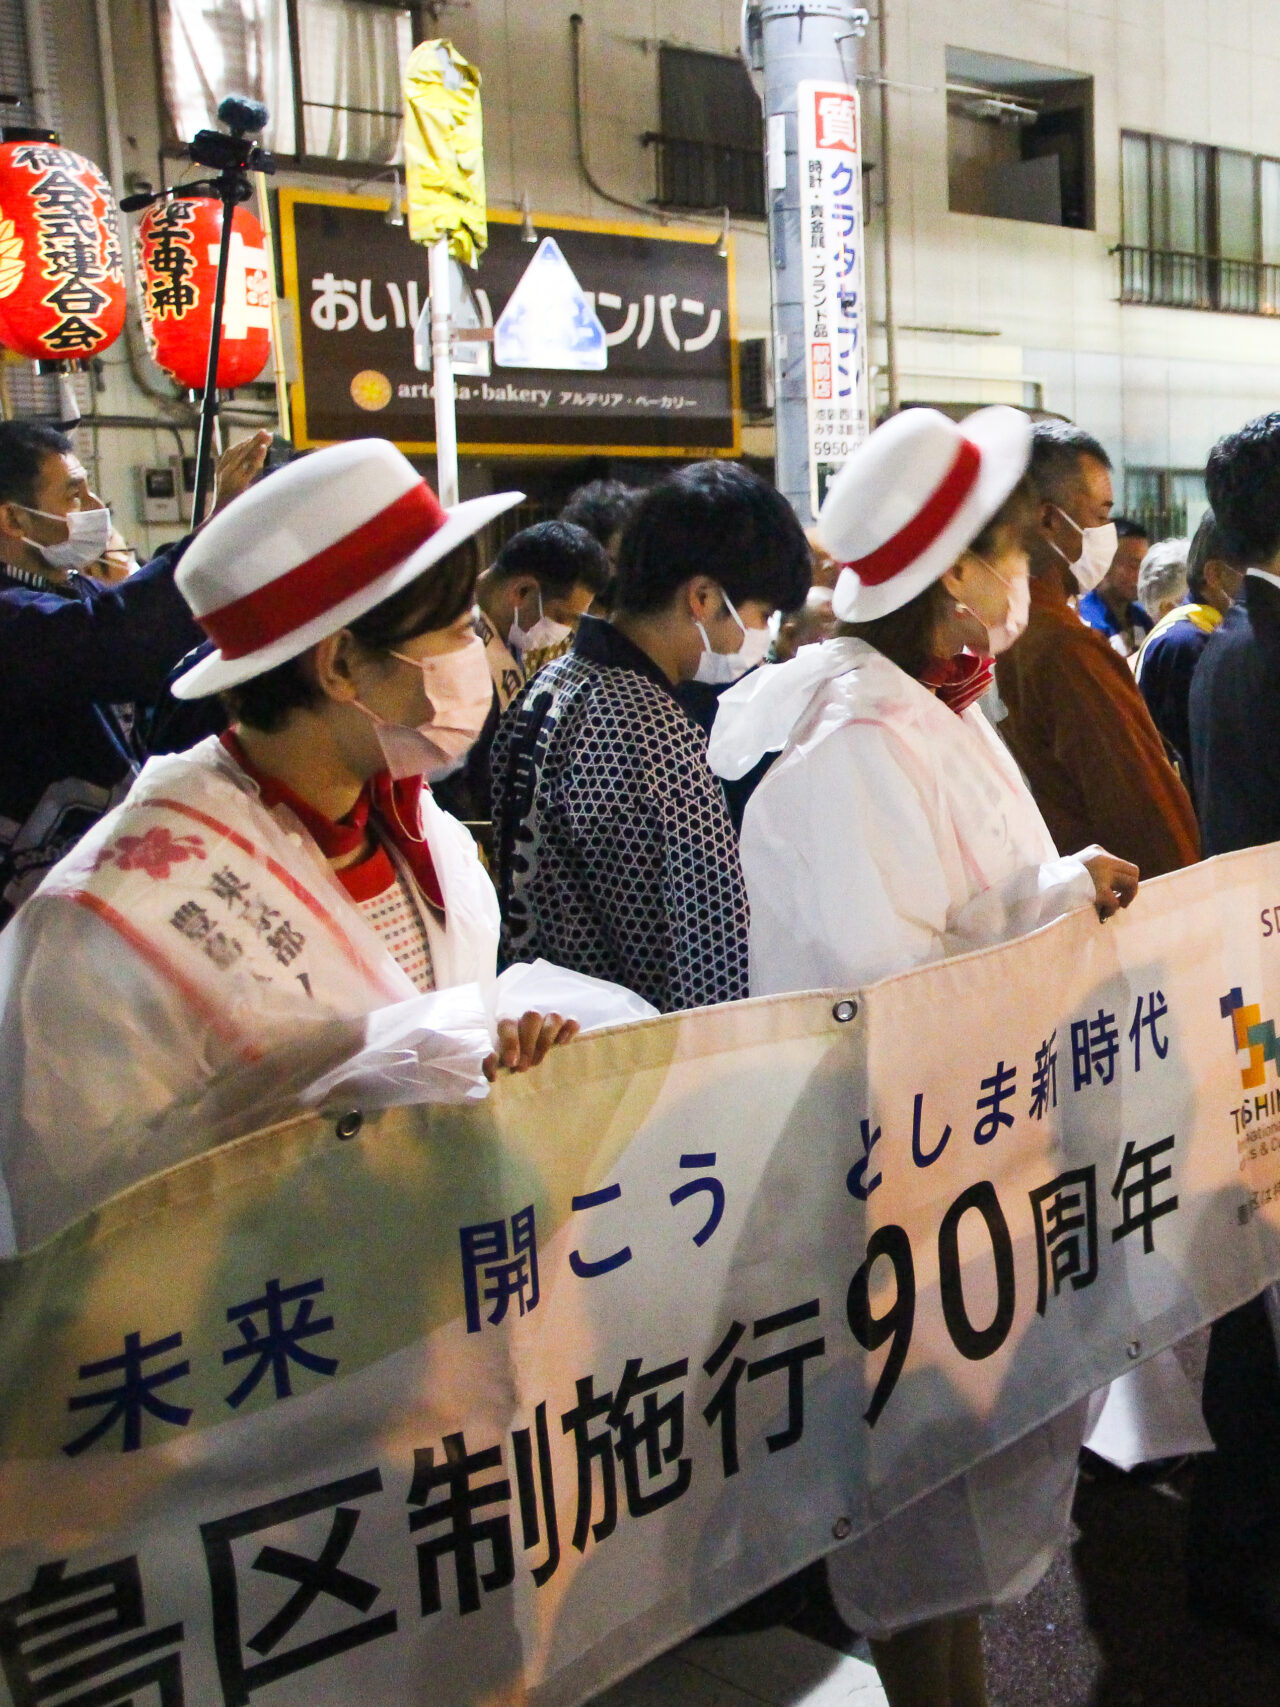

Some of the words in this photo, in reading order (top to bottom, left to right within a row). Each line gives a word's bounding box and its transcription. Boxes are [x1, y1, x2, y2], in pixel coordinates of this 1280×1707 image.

[818, 96, 857, 150] 質
[63, 1277, 340, 1458] 未来
[458, 1151, 726, 1334] 開こう
[845, 989, 1169, 1201] としま新時代
